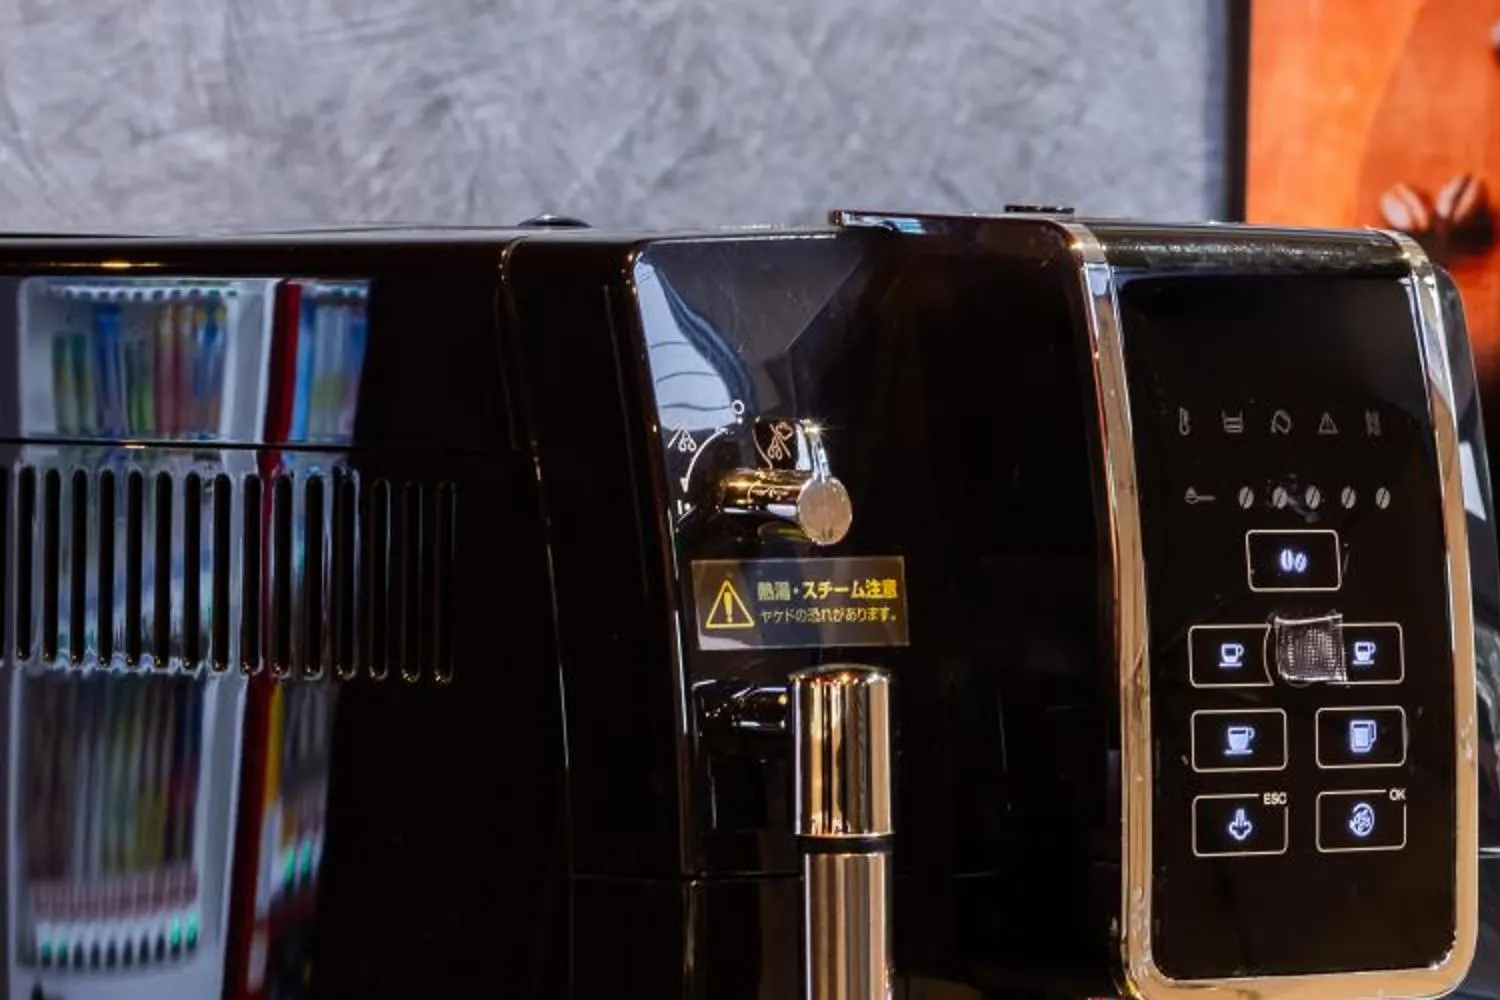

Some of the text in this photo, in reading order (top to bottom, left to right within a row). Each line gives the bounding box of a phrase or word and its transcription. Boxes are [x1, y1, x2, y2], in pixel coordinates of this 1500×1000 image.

[757, 578, 898, 601] 熱湯・スチーム注意
[1263, 791, 1287, 805] ESC
[1389, 788, 1406, 801] OK
